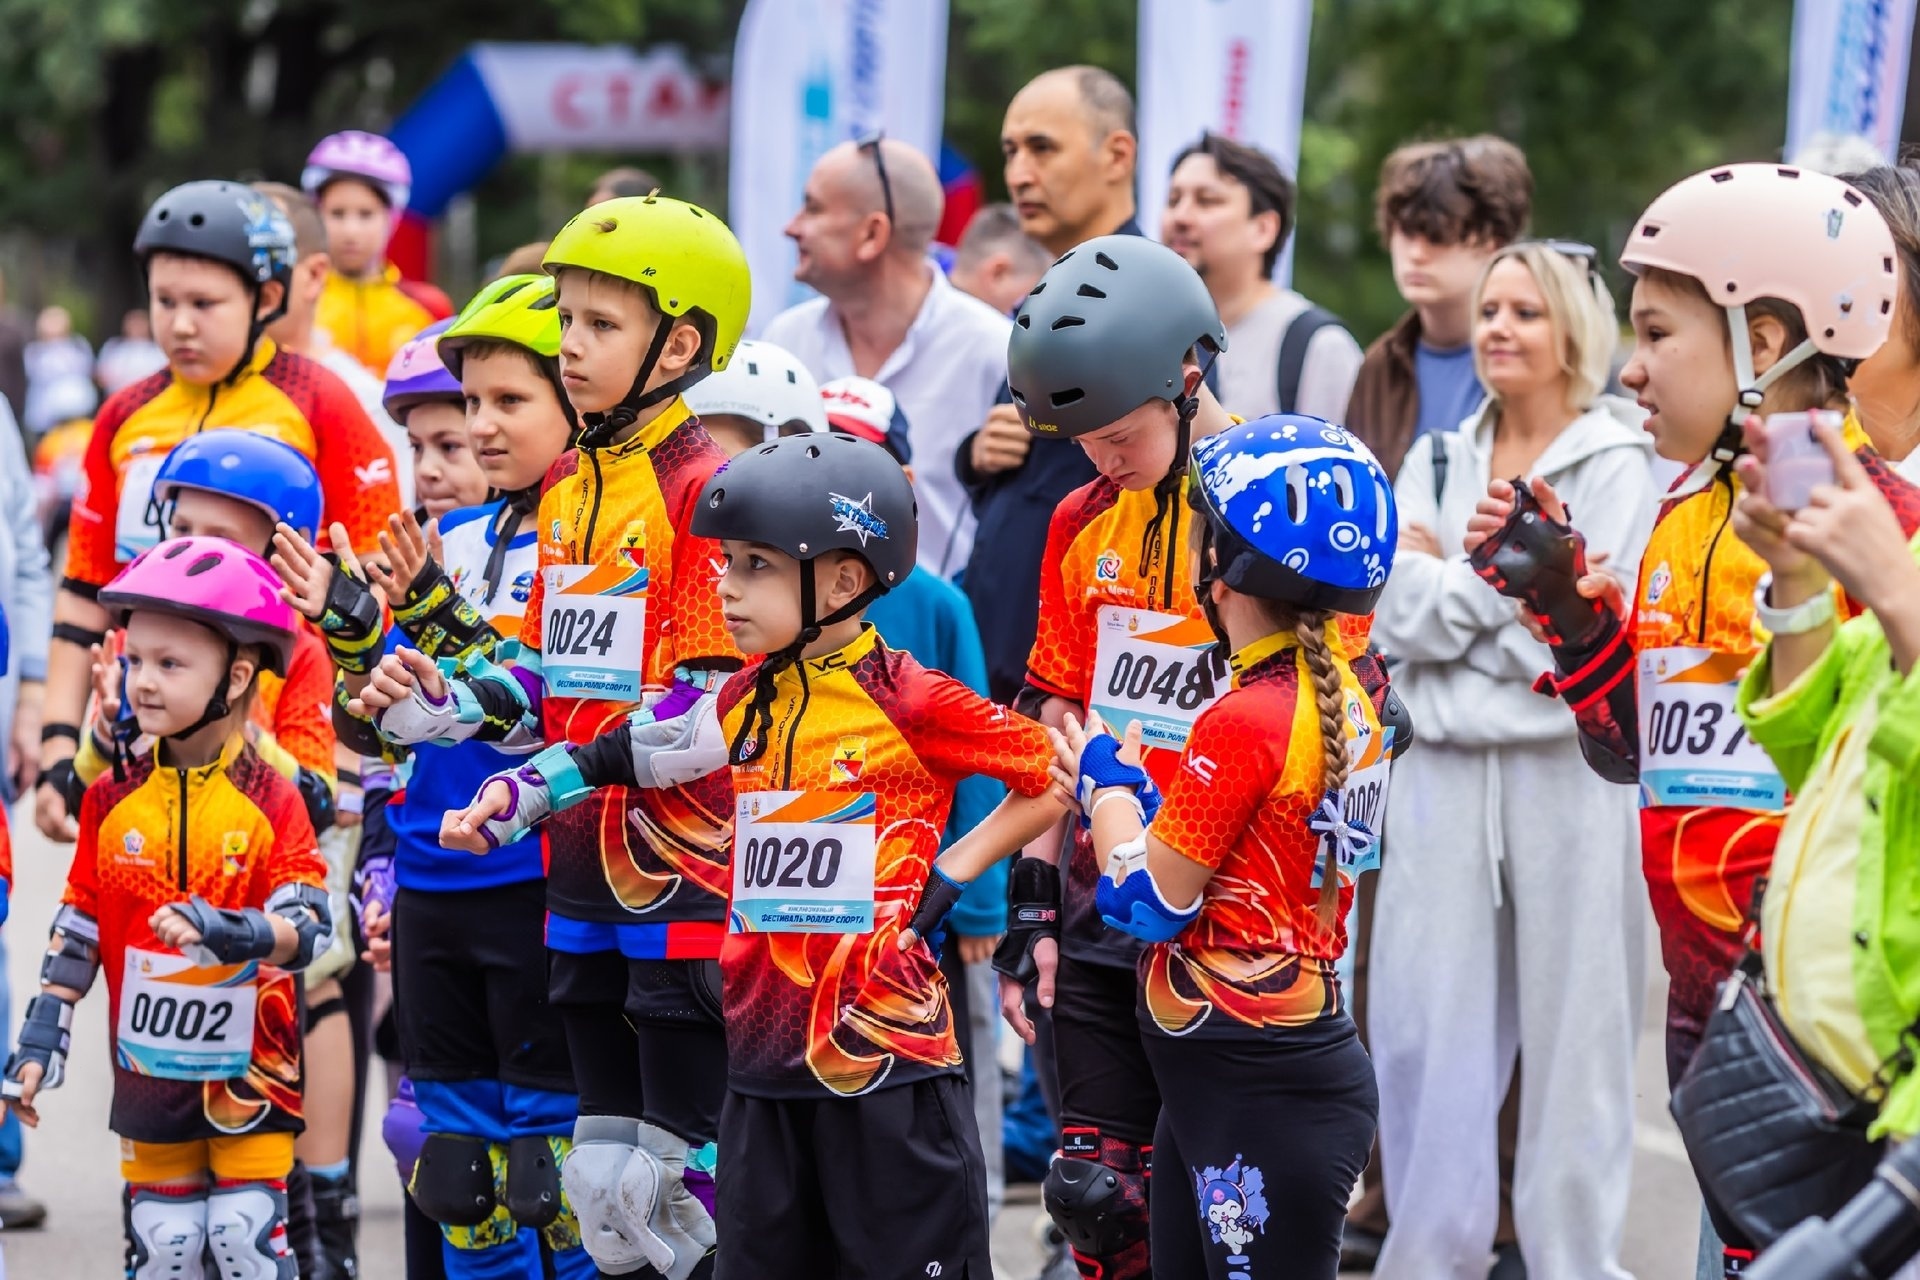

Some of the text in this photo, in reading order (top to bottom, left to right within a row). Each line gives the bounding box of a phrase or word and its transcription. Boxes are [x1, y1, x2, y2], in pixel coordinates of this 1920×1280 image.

[551, 70, 730, 131] СТА
[574, 478, 588, 533] VICTORY
[548, 609, 618, 656] 0024
[1108, 652, 1205, 710] 0048
[1141, 727, 1166, 739] ТИВАЛЬ
[744, 837, 842, 888] 0020
[761, 914, 865, 925] ФЕСТИВАЛЬ РОЛЛЕР СПОРТА
[131, 993, 233, 1041] 0002
